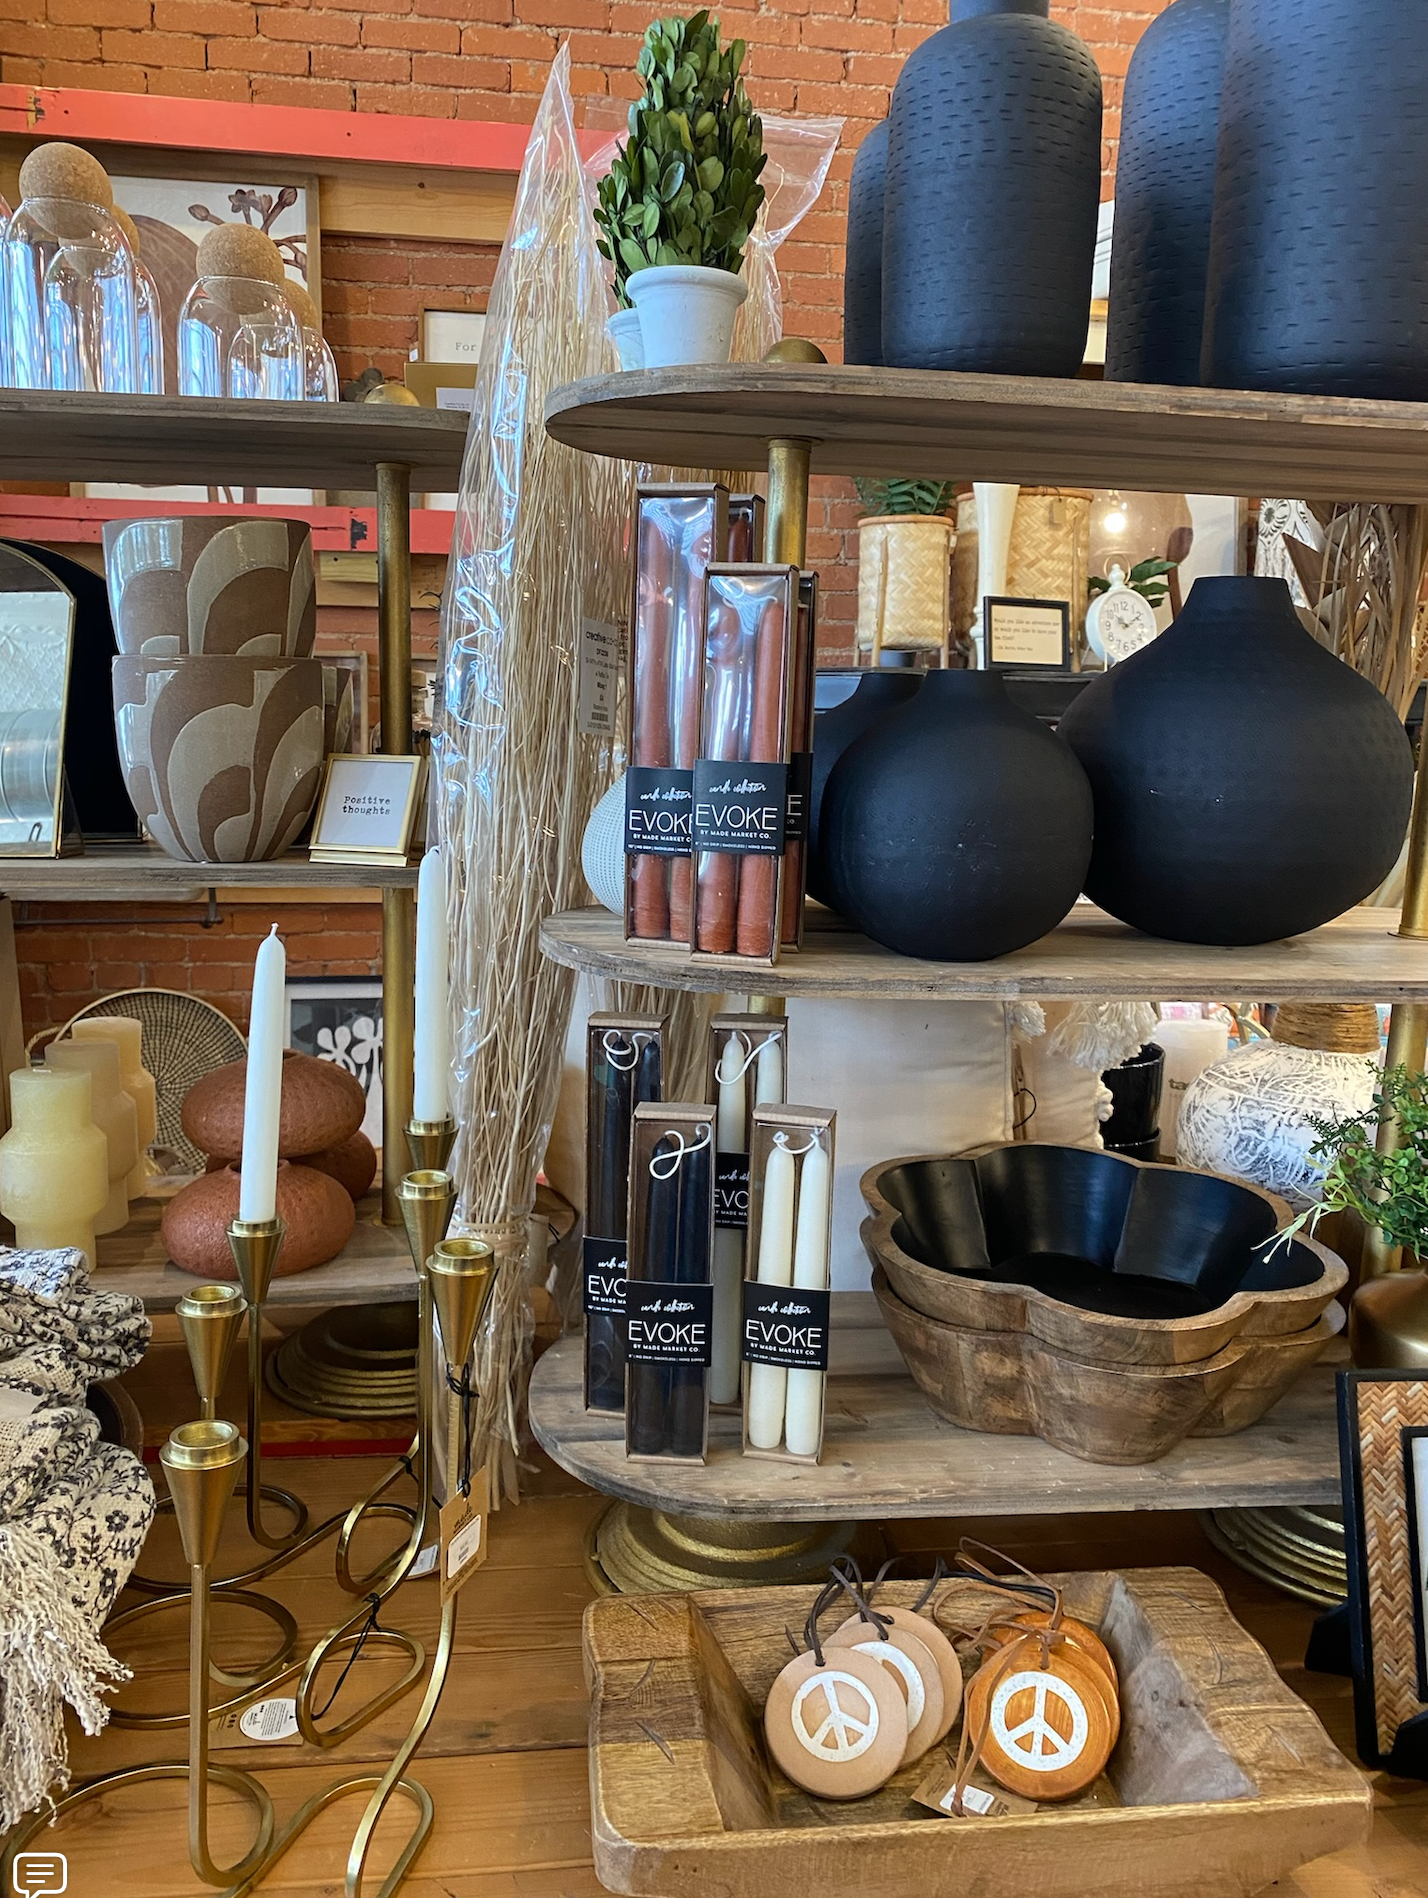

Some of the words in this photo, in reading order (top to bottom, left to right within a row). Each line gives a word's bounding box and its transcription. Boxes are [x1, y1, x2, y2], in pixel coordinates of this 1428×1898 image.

[1113, 603, 1119, 613] 11
[1120, 601, 1128, 611] 12
[1106, 609, 1114, 619] 10
[1105, 620, 1111, 631] 9
[1108, 632, 1114, 642] 8
[1116, 639, 1121, 649] 7
[1123, 642, 1129, 651] 6
[1131, 641, 1137, 650] 5
[343, 796, 391, 805] Positive
[342, 805, 391, 816] thoughts
[695, 804, 778, 830] EVOKE
[731, 831, 757, 839] MARKET
[588, 1274, 627, 1297] EVO
[628, 1320, 706, 1345] EVOKE
[746, 1319, 822, 1348] EVOKE
[759, 1344, 777, 1352] MADE
[779, 1347, 803, 1355] MARKET
